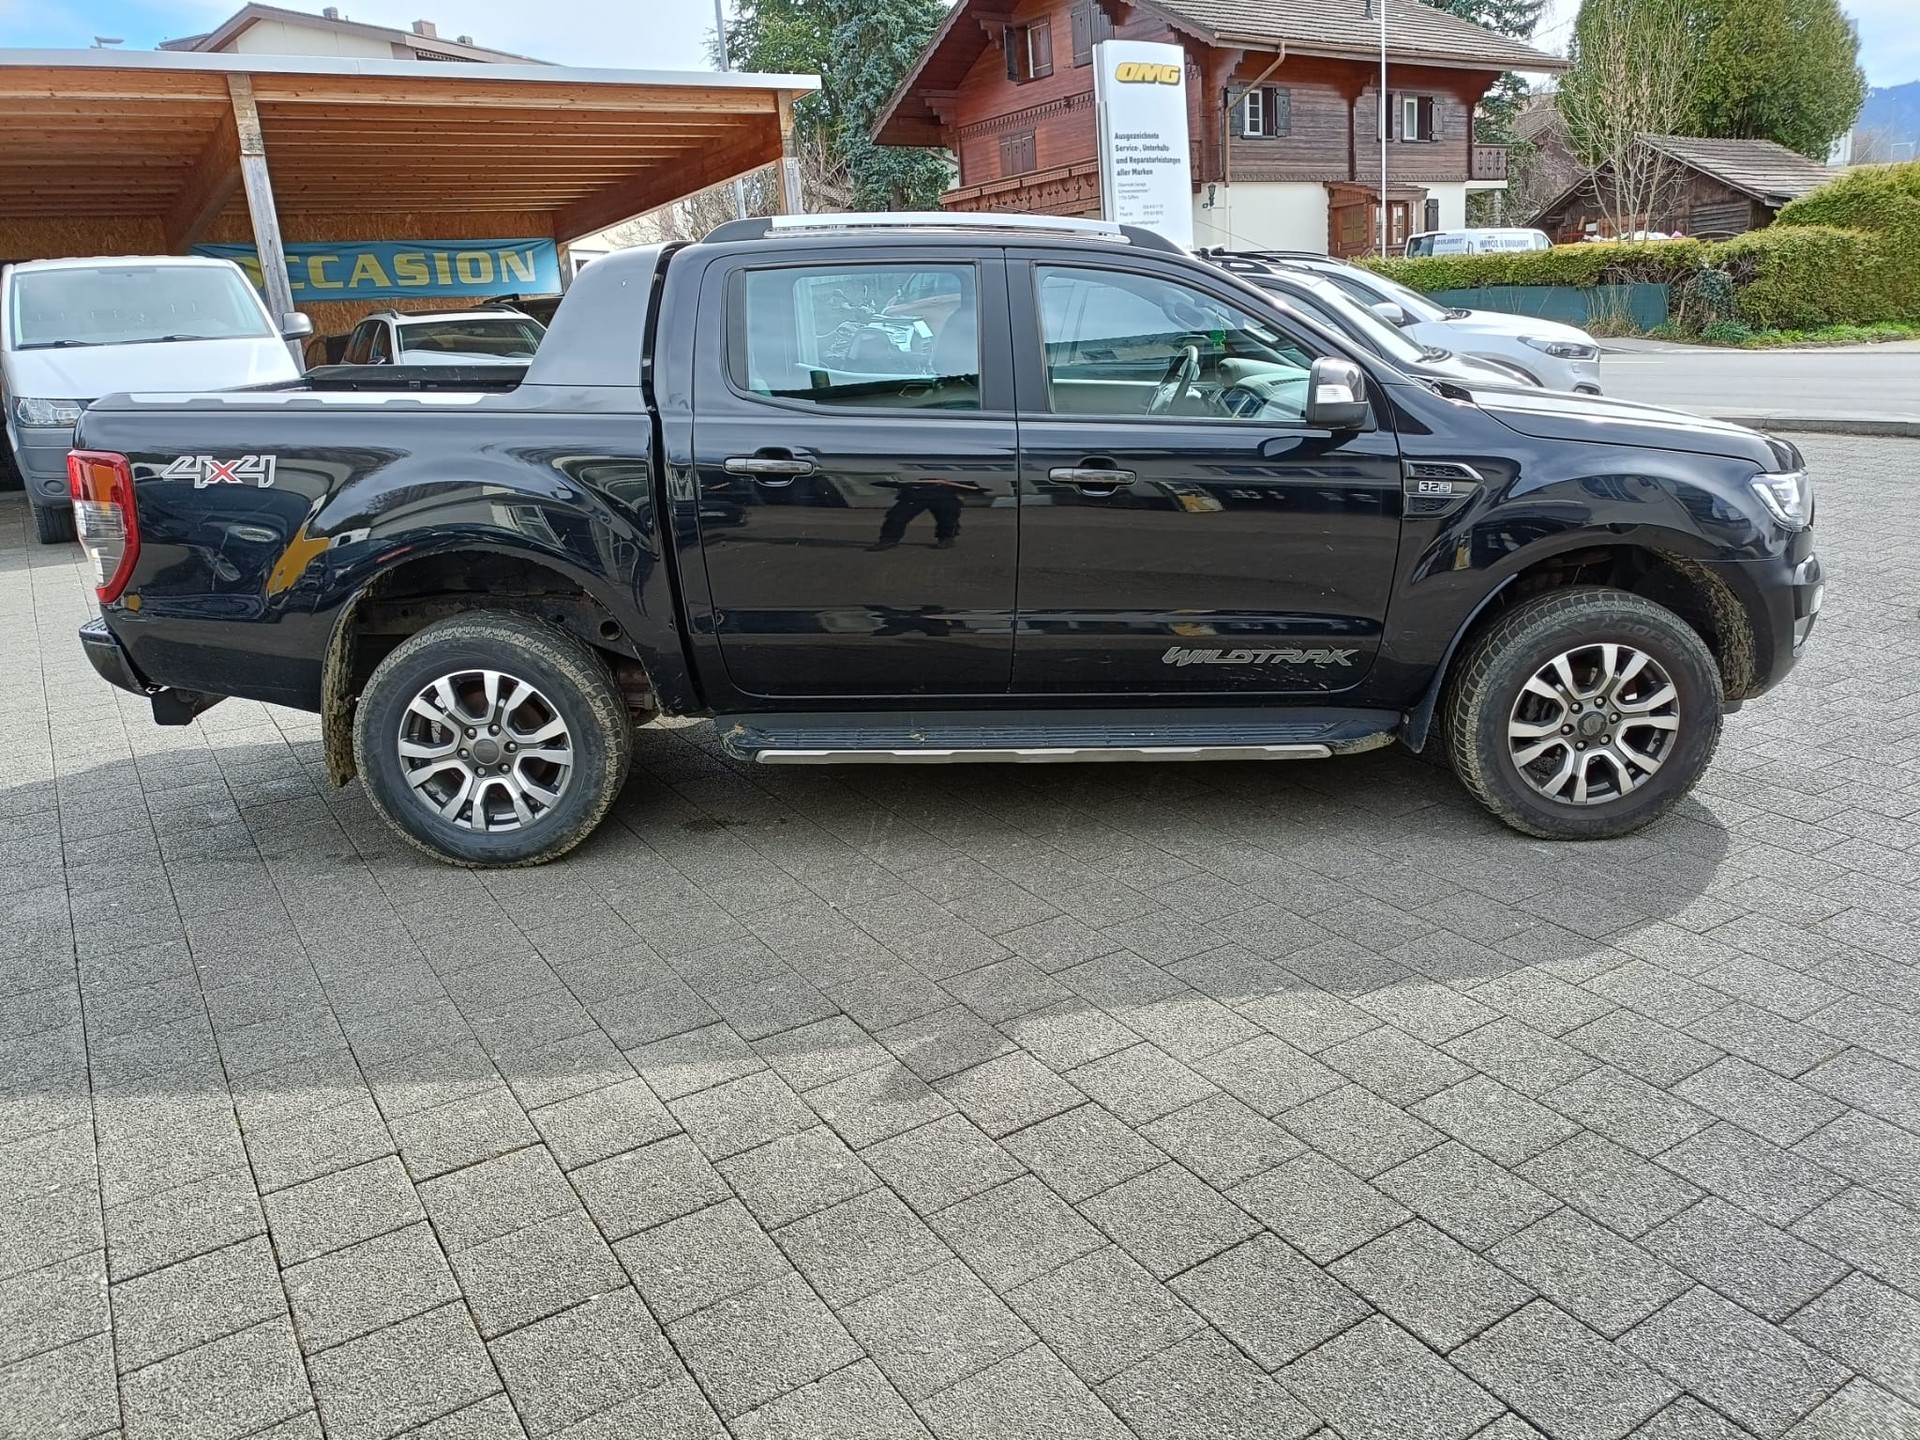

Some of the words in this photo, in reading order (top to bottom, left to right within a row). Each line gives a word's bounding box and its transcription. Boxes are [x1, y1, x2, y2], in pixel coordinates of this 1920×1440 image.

[1115, 62, 1181, 86] OMG
[1114, 132, 1159, 141] Ausgezeichnete
[1116, 156, 1128, 164] und
[1116, 168, 1130, 176] aller
[1131, 168, 1153, 176] Marken
[1161, 646, 1360, 667] WILDTRAK
